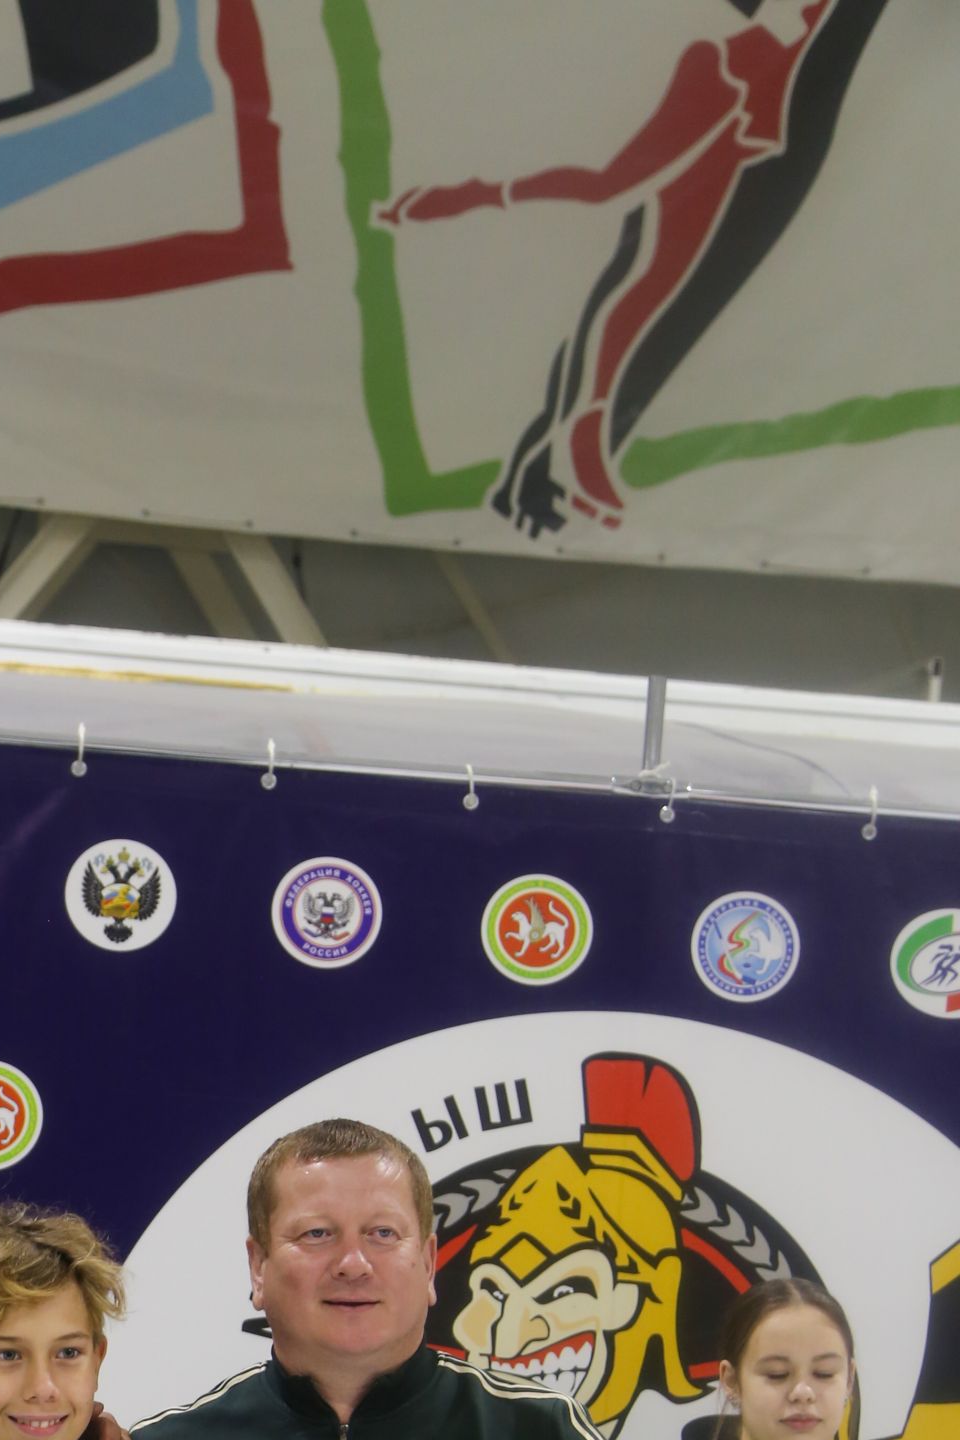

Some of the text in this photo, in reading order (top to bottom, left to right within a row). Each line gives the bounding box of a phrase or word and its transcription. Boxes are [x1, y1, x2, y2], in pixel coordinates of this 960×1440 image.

[285, 868, 372, 915] ФЕДЕРАЦИЯ ХОККЕЯ
[302, 942, 348, 957] РОССИИ
[411, 1078, 533, 1153] ЫШ
